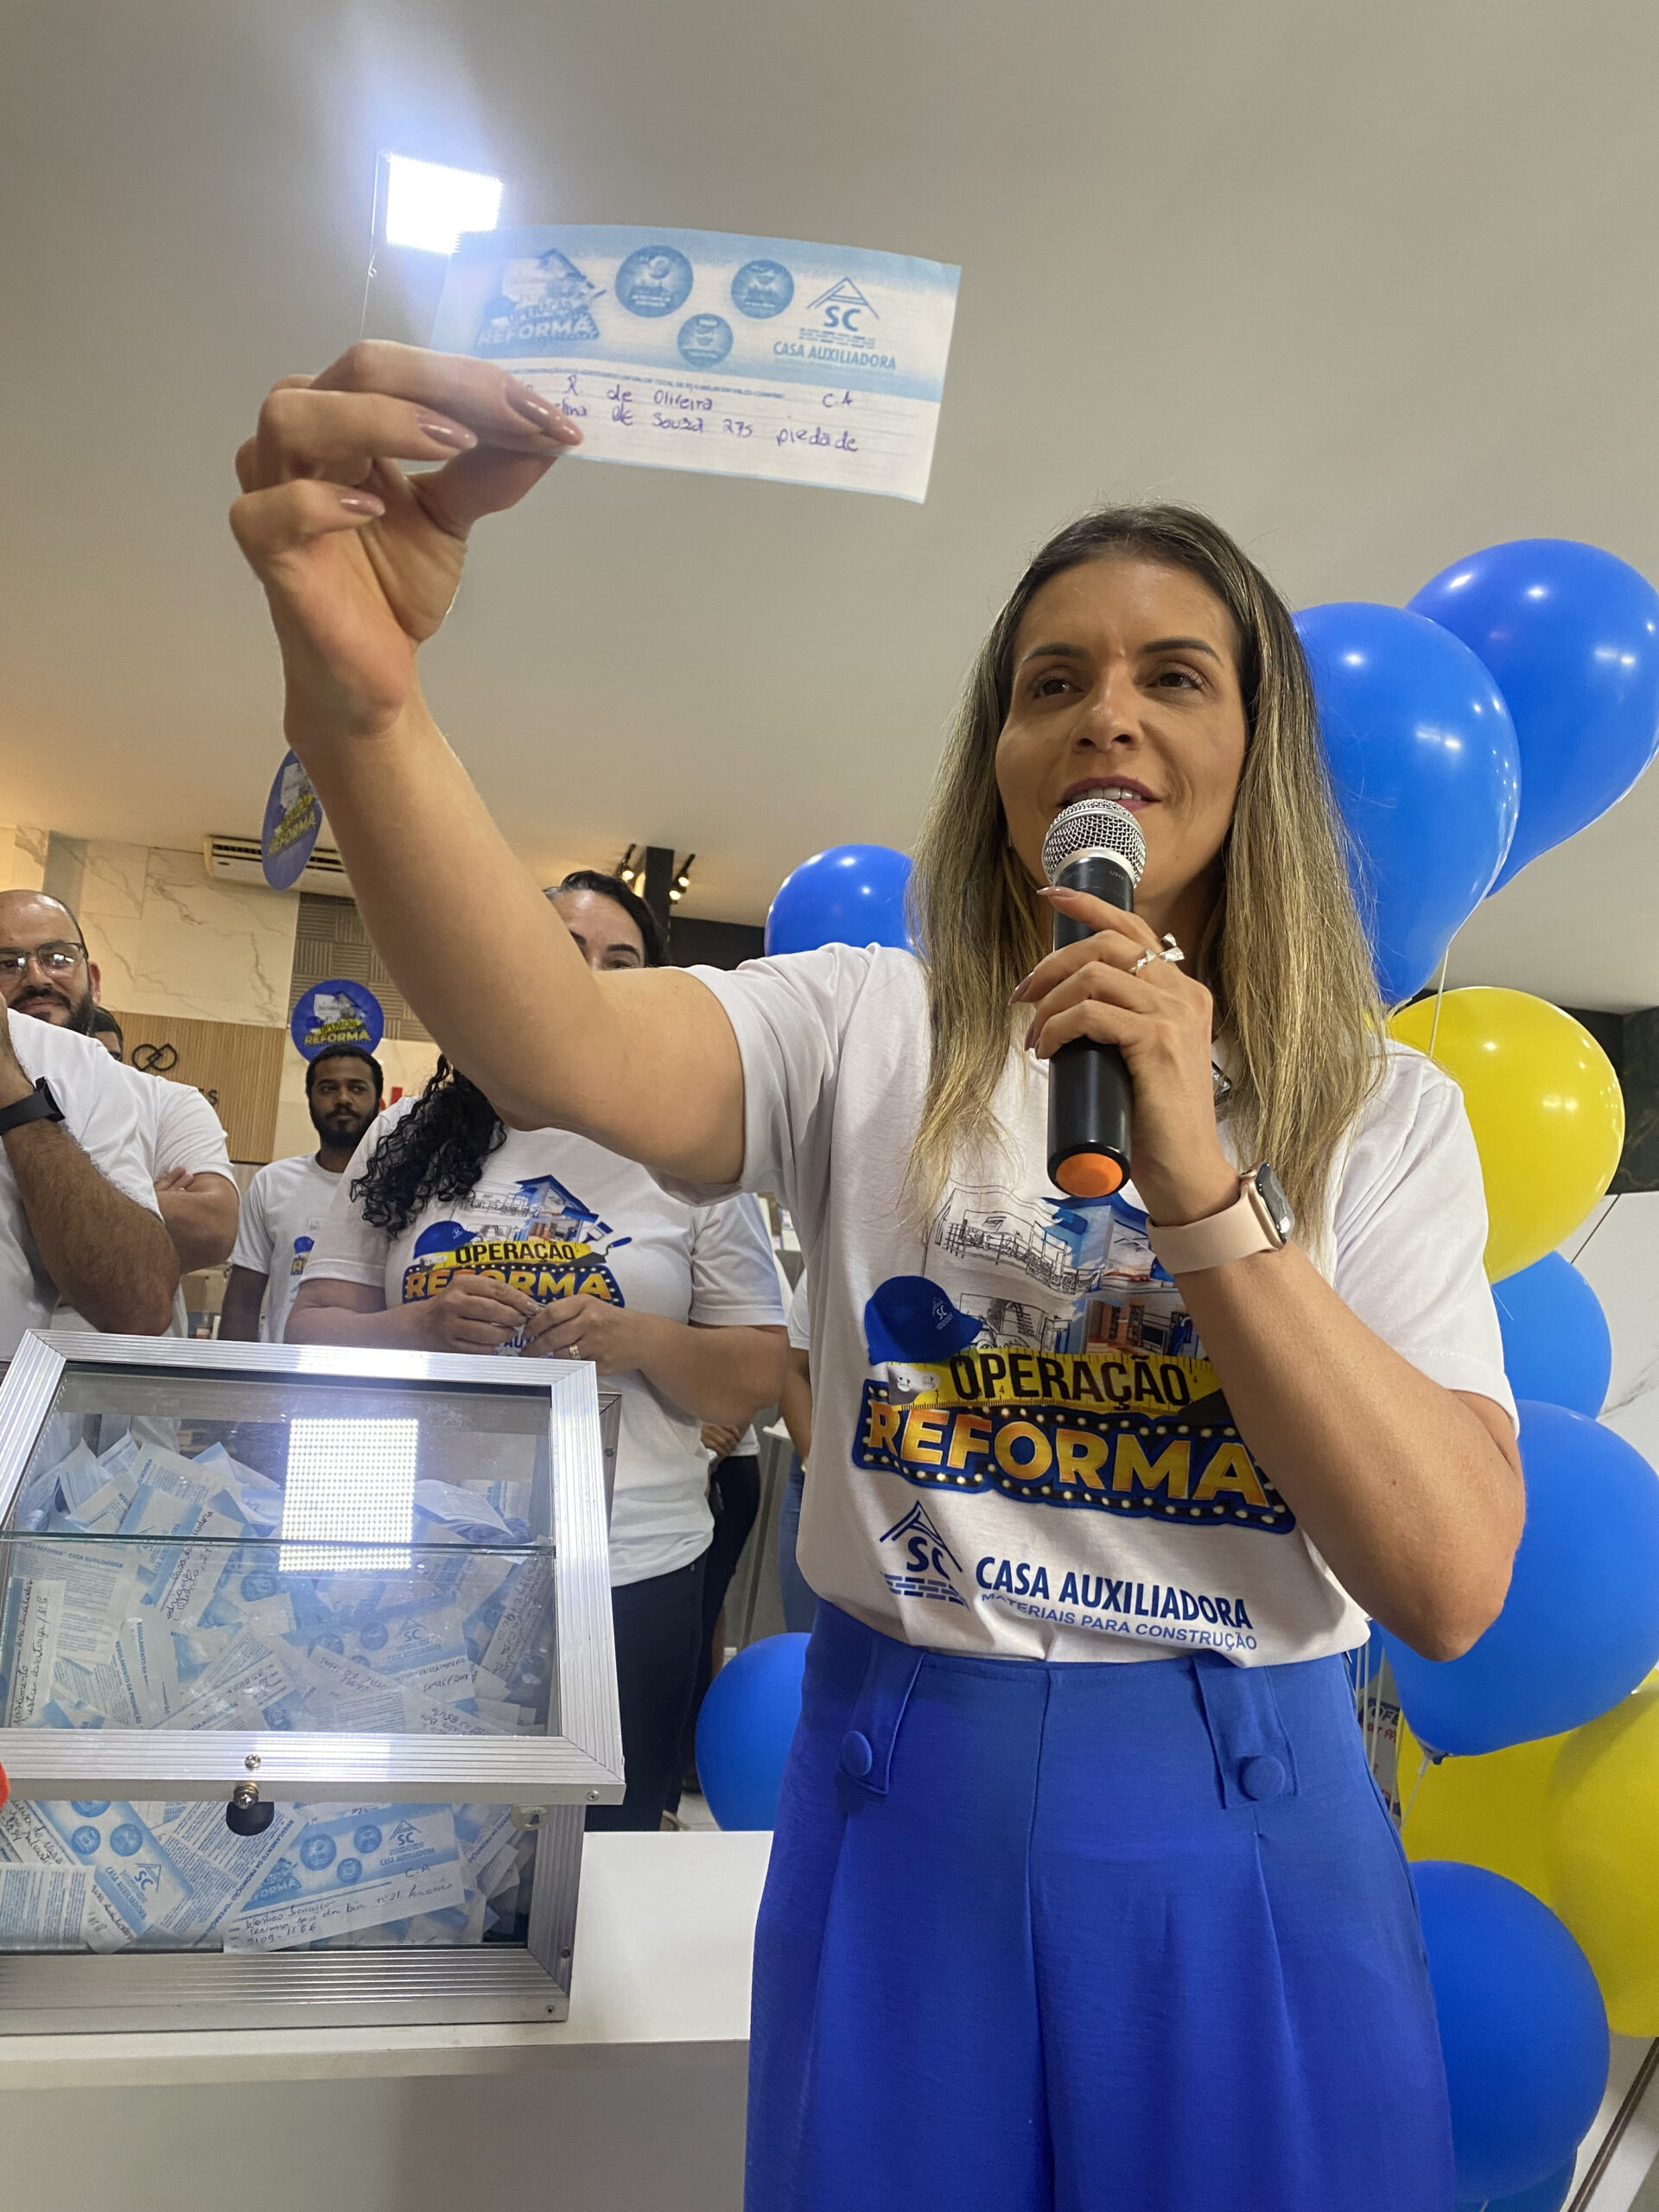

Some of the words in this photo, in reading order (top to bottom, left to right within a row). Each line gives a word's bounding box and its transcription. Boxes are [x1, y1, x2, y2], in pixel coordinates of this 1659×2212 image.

[823, 305, 861, 332] SC
[772, 341, 804, 358] CASA
[808, 346, 896, 370] AUXILIADORA
[607, 385, 632, 403] de
[304, 1032, 372, 1045] REFORMA
[454, 1242, 576, 1264] OPERAÇÃO
[406, 1269, 612, 1300] RERMA
[950, 1352, 1192, 1411] OPERAÇÃO
[868, 1402, 1270, 1508] REFORMA
[906, 1536, 950, 1580] SC
[976, 1557, 1050, 1600] CASA
[1058, 1572, 1253, 1630] AUXILIADORA
[982, 1593, 1077, 1628] MATERIAIS
[1080, 1615, 1130, 1636] PARA
[1135, 1624, 1258, 1651] CONSTRUÇÃO
[262, 1820, 294, 1861] REGULAMENTO
[397, 1832, 415, 1847] SC
[134, 1870, 154, 1891] SC
[232, 1867, 257, 1901] PROMOÇÃO
